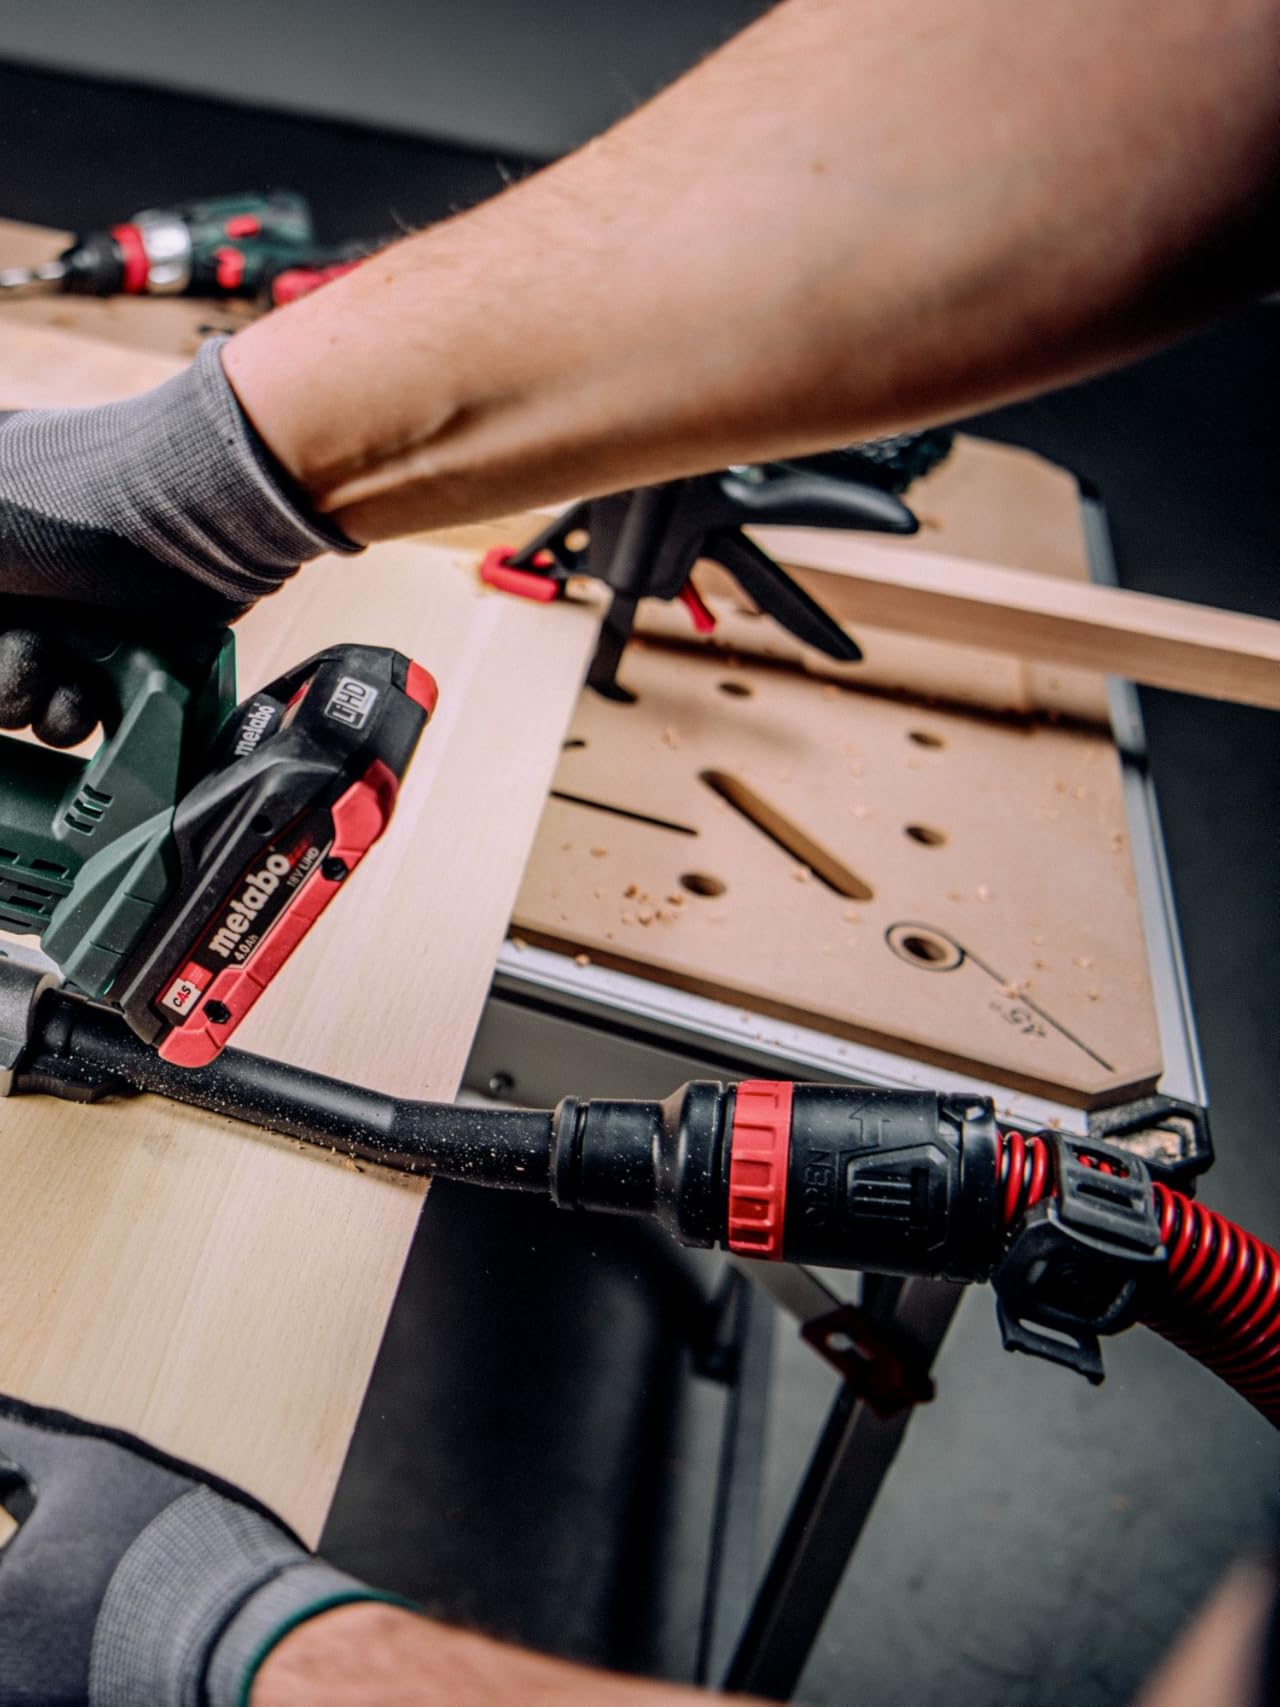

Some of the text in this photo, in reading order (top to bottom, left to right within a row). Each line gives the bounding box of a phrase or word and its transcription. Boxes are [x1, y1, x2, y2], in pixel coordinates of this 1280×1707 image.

[332, 681, 367, 724] LiHD
[234, 702, 276, 757] metabo
[208, 853, 290, 958] metabo
[173, 984, 192, 1008] CAS
